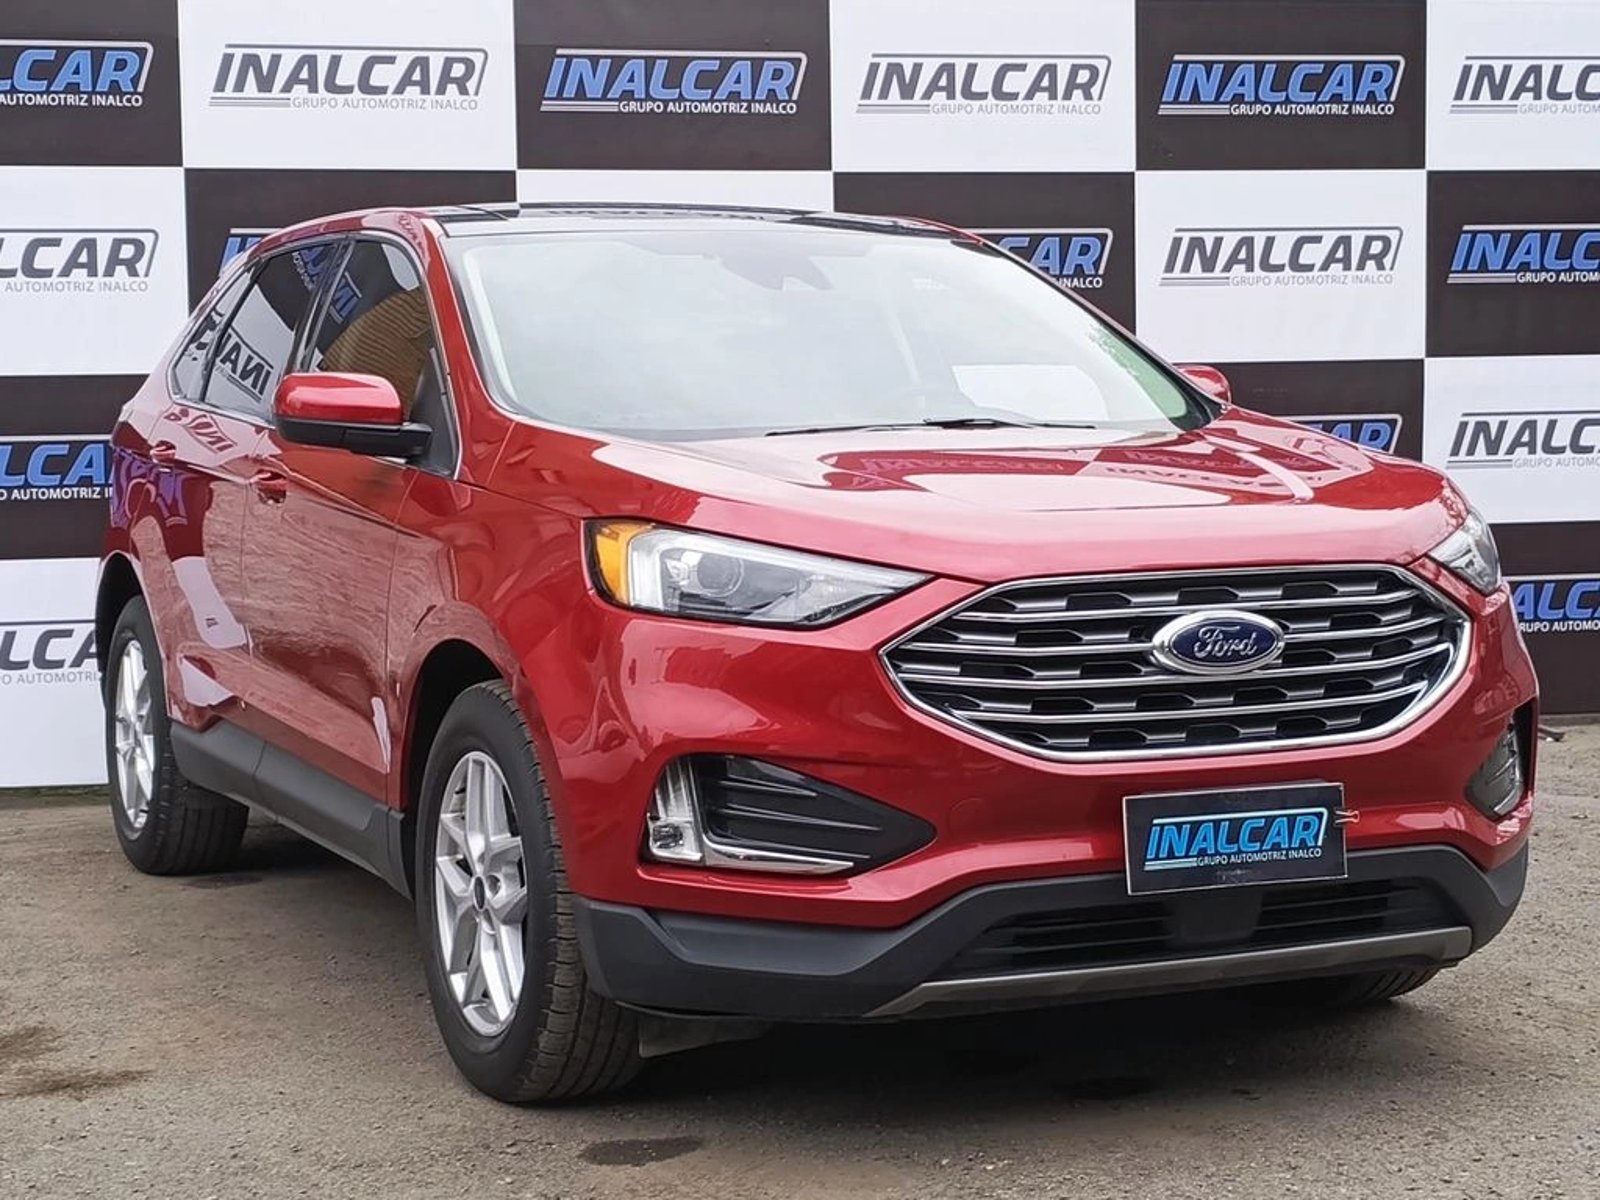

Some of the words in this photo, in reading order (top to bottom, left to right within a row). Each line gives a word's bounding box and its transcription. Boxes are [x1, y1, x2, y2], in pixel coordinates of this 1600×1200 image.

[0, 49, 140, 92] CAR
[213, 53, 476, 95] INALCAR
[544, 58, 795, 100] INALCAR
[860, 62, 1100, 101] INALCAR
[1162, 63, 1394, 102] INALCAR
[1453, 64, 1600, 101] INALC
[92, 94, 143, 107] INALCO
[292, 97, 338, 109] GRUPO
[342, 98, 427, 110] AUTOMOTRIZ
[430, 99, 478, 110] INALCO
[620, 101, 664, 112] GRUPO
[667, 102, 748, 113] AUTOMOTRIZ
[751, 102, 797, 114] INALCO
[931, 103, 974, 114] GRUPO
[977, 104, 1054, 114] AUTOMOTRIZ
[1058, 104, 1101, 115] INALCO
[1230, 104, 1271, 115] GRUPO
[1274, 104, 1349, 115] AUTOMOTRIZ
[1352, 104, 1395, 115] INALCO
[1519, 103, 1558, 113] GRUPO
[1163, 235, 1392, 273] INALCAR
[1231, 275, 1271, 286] GRUPO
[1274, 275, 1349, 286] AUTOMOTRIZ
[1352, 274, 1393, 285] INALCO
[1516, 272, 1555, 283] GRUPO
[1559, 271, 1600, 282] AUTOM
[4, 281, 95, 292] AUTOMOTRIZ
[99, 280, 148, 292] INALCO
[1450, 418, 1600, 456] INALC
[1514, 457, 1552, 468] GRUPO
[11, 487, 100, 500] AUTOMOTRIZ
[1194, 625, 1257, 658] Ford
[17, 671, 100, 684] AUTOMOTRI
[1146, 815, 1320, 859] INALCAR
[1197, 855, 1228, 866] GRUPO
[1229, 850, 1286, 864] AUTOMOTRIZ
[1288, 848, 1322, 859] INALCO
